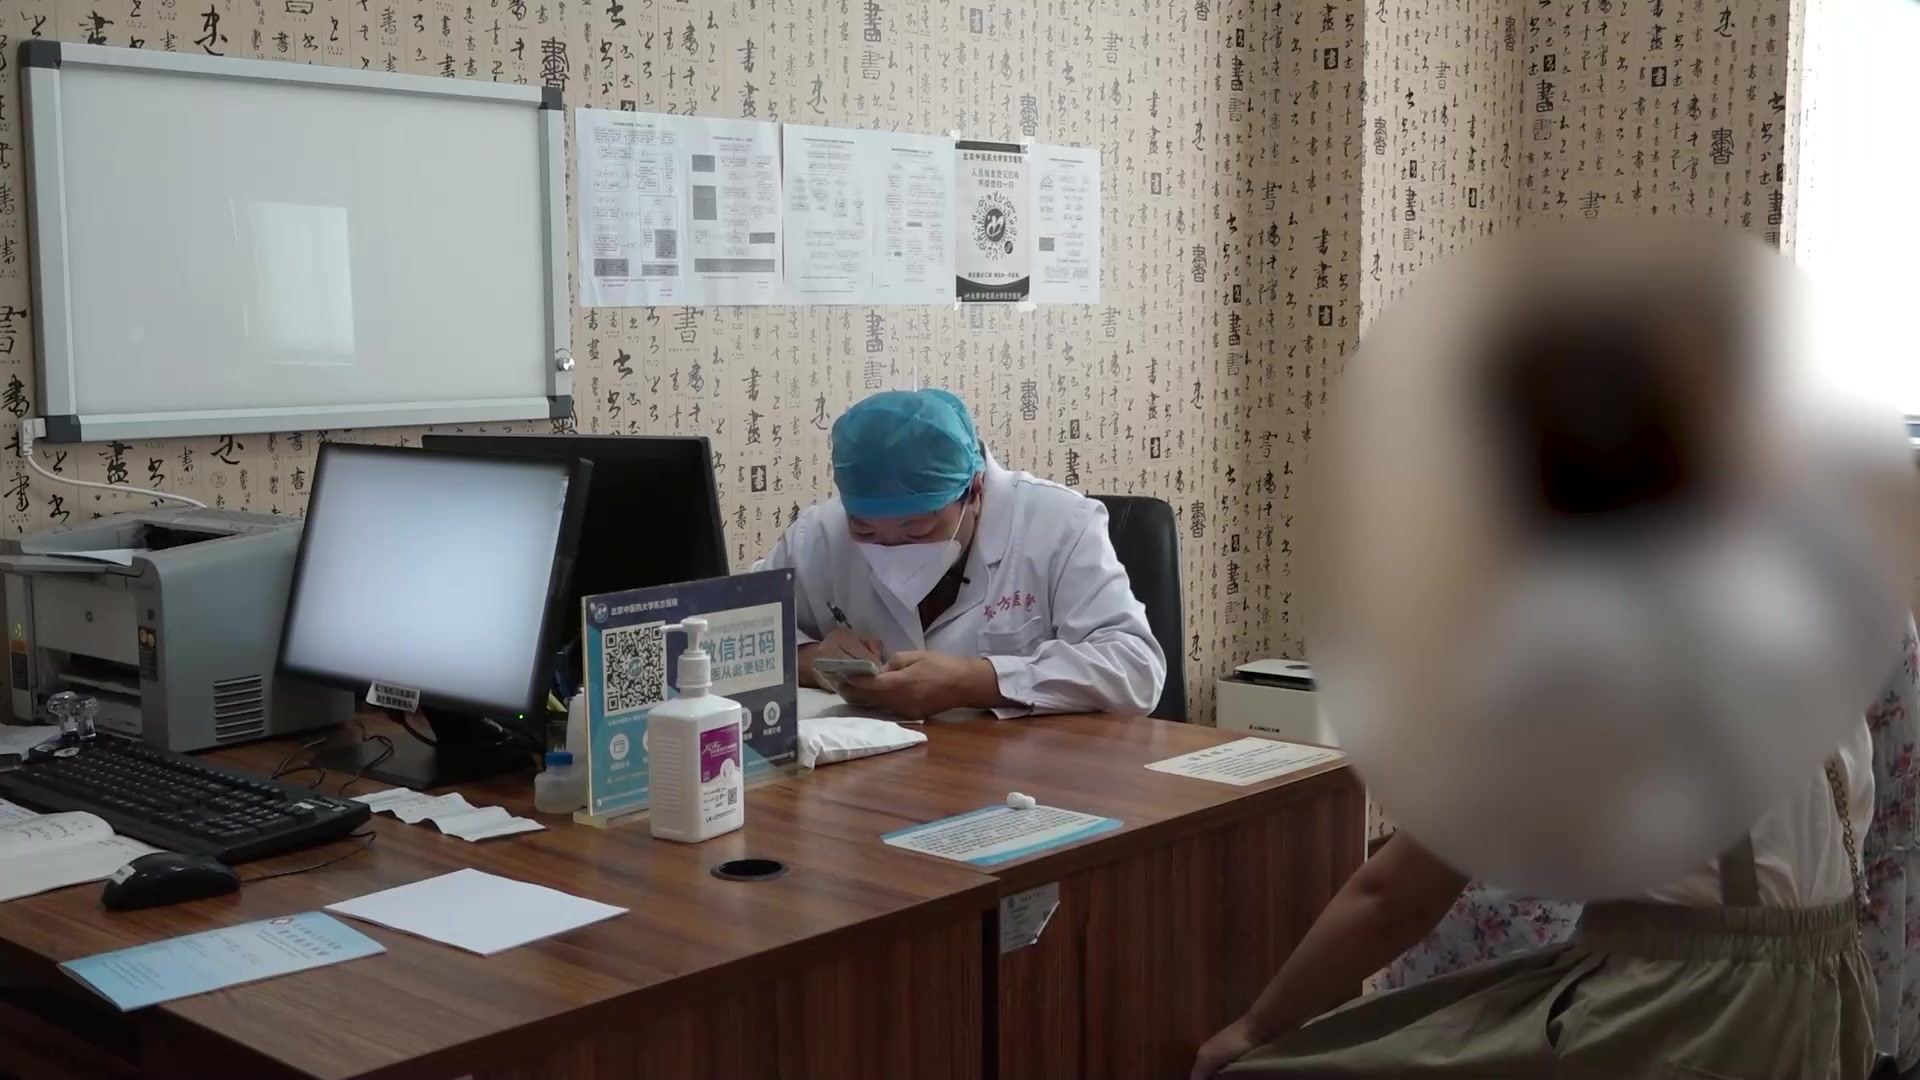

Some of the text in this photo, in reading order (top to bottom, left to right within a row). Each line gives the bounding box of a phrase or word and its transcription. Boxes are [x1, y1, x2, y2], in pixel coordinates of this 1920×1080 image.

[610, 598, 678, 616] 北京中医药大学东方医院
